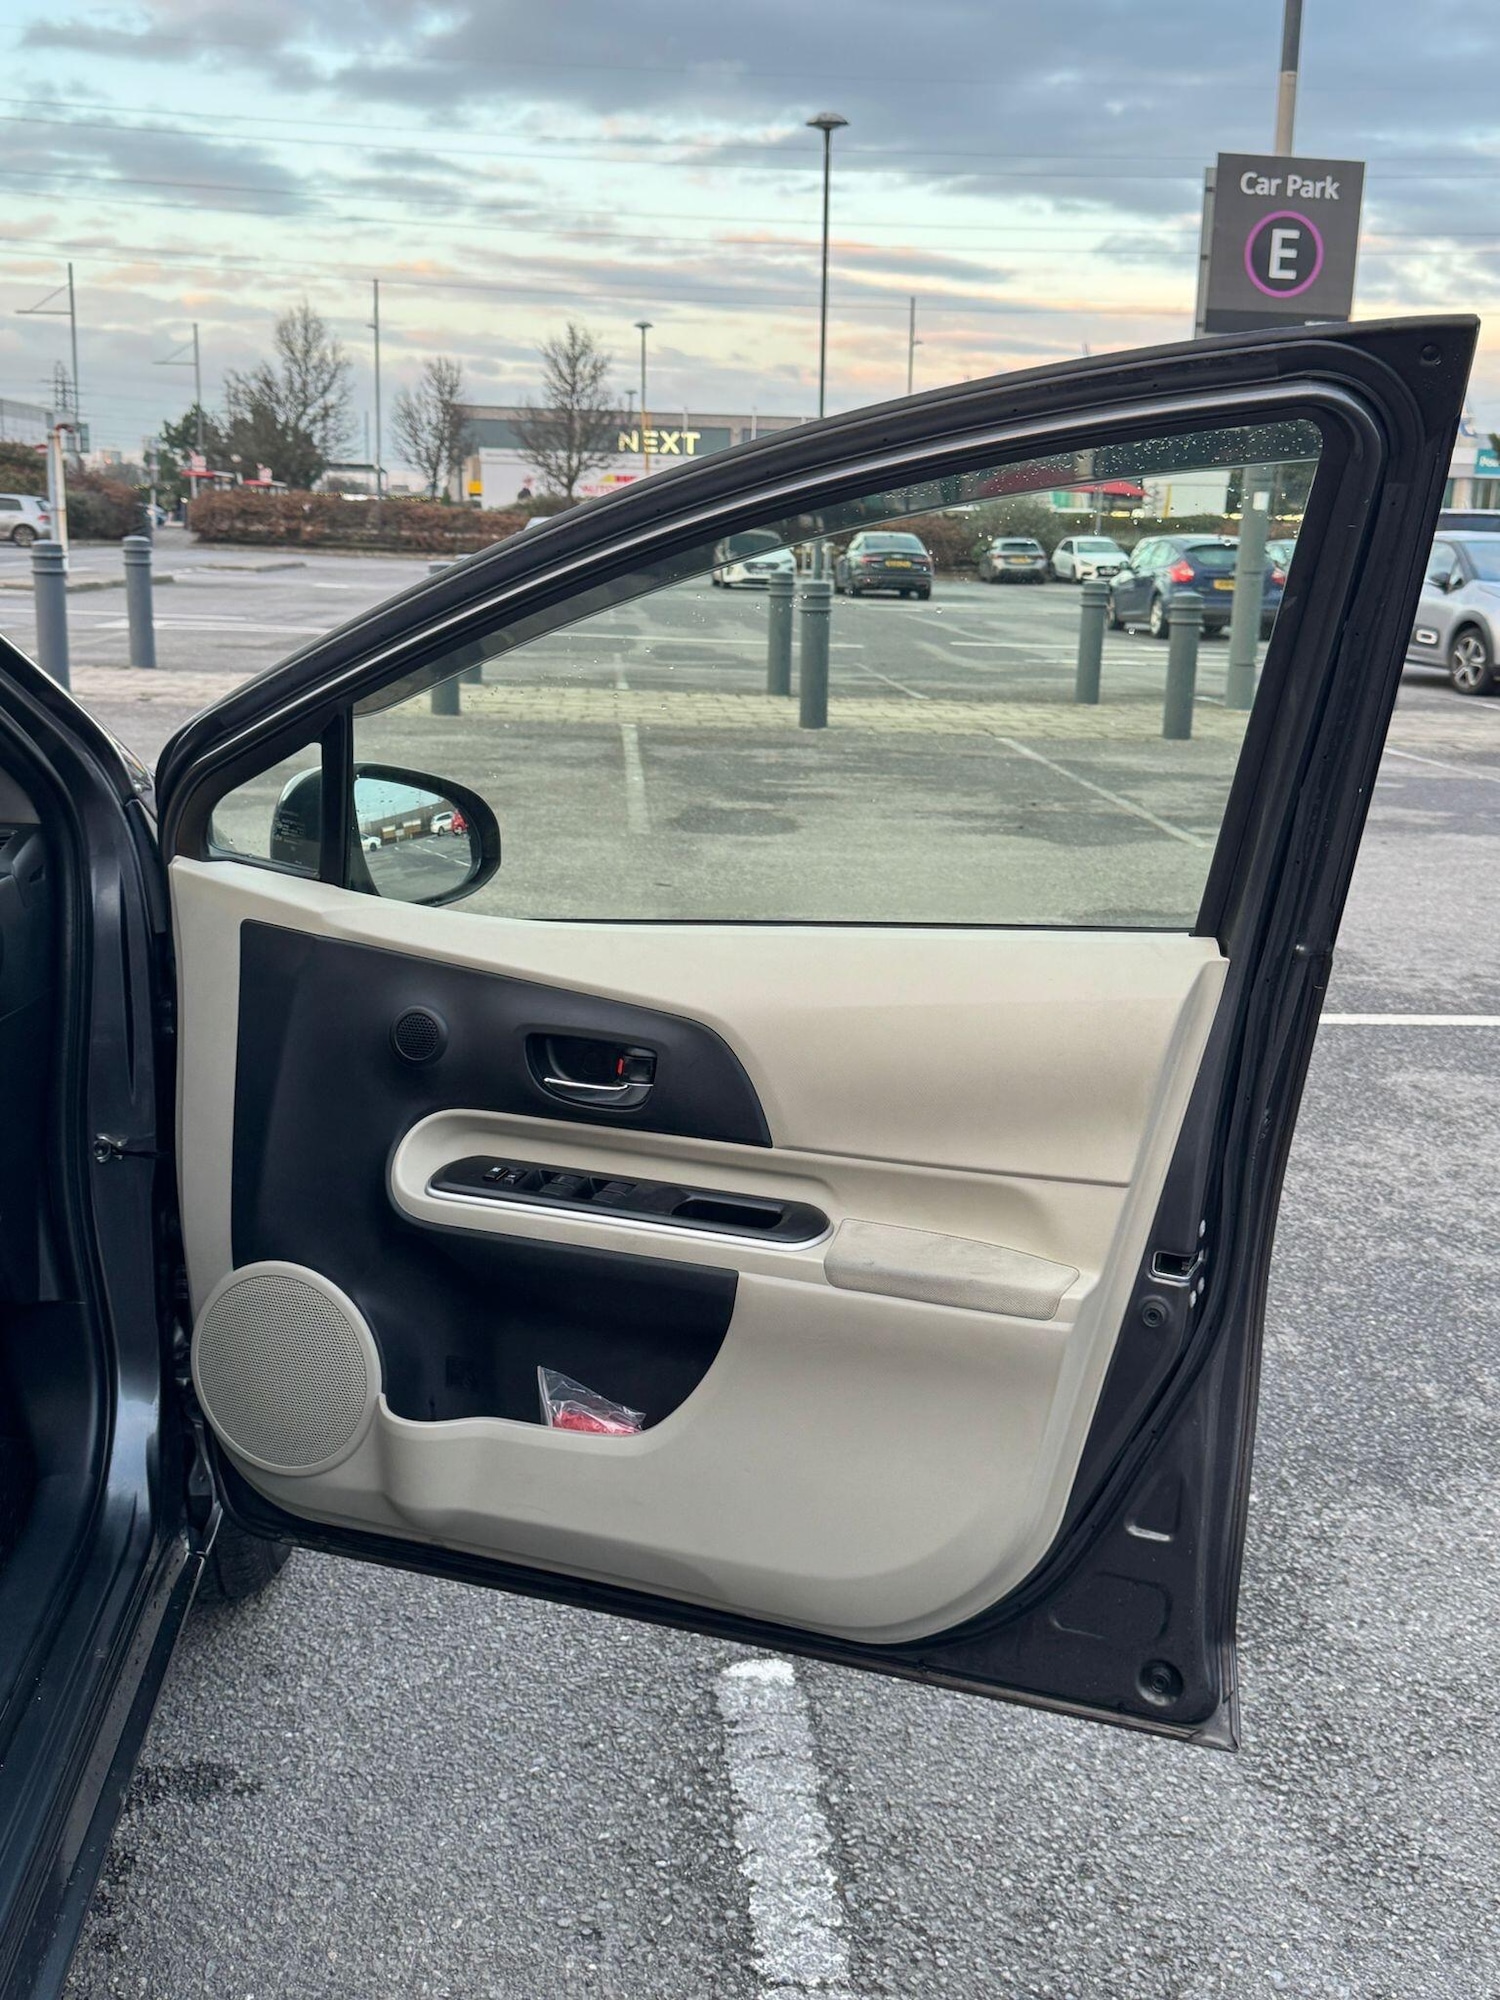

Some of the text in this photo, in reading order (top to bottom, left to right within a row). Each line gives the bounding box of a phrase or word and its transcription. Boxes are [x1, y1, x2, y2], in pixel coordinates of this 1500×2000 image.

[1240, 171, 1340, 200] Car Park
[1268, 227, 1301, 280] E
[618, 429, 701, 455] NEXT
